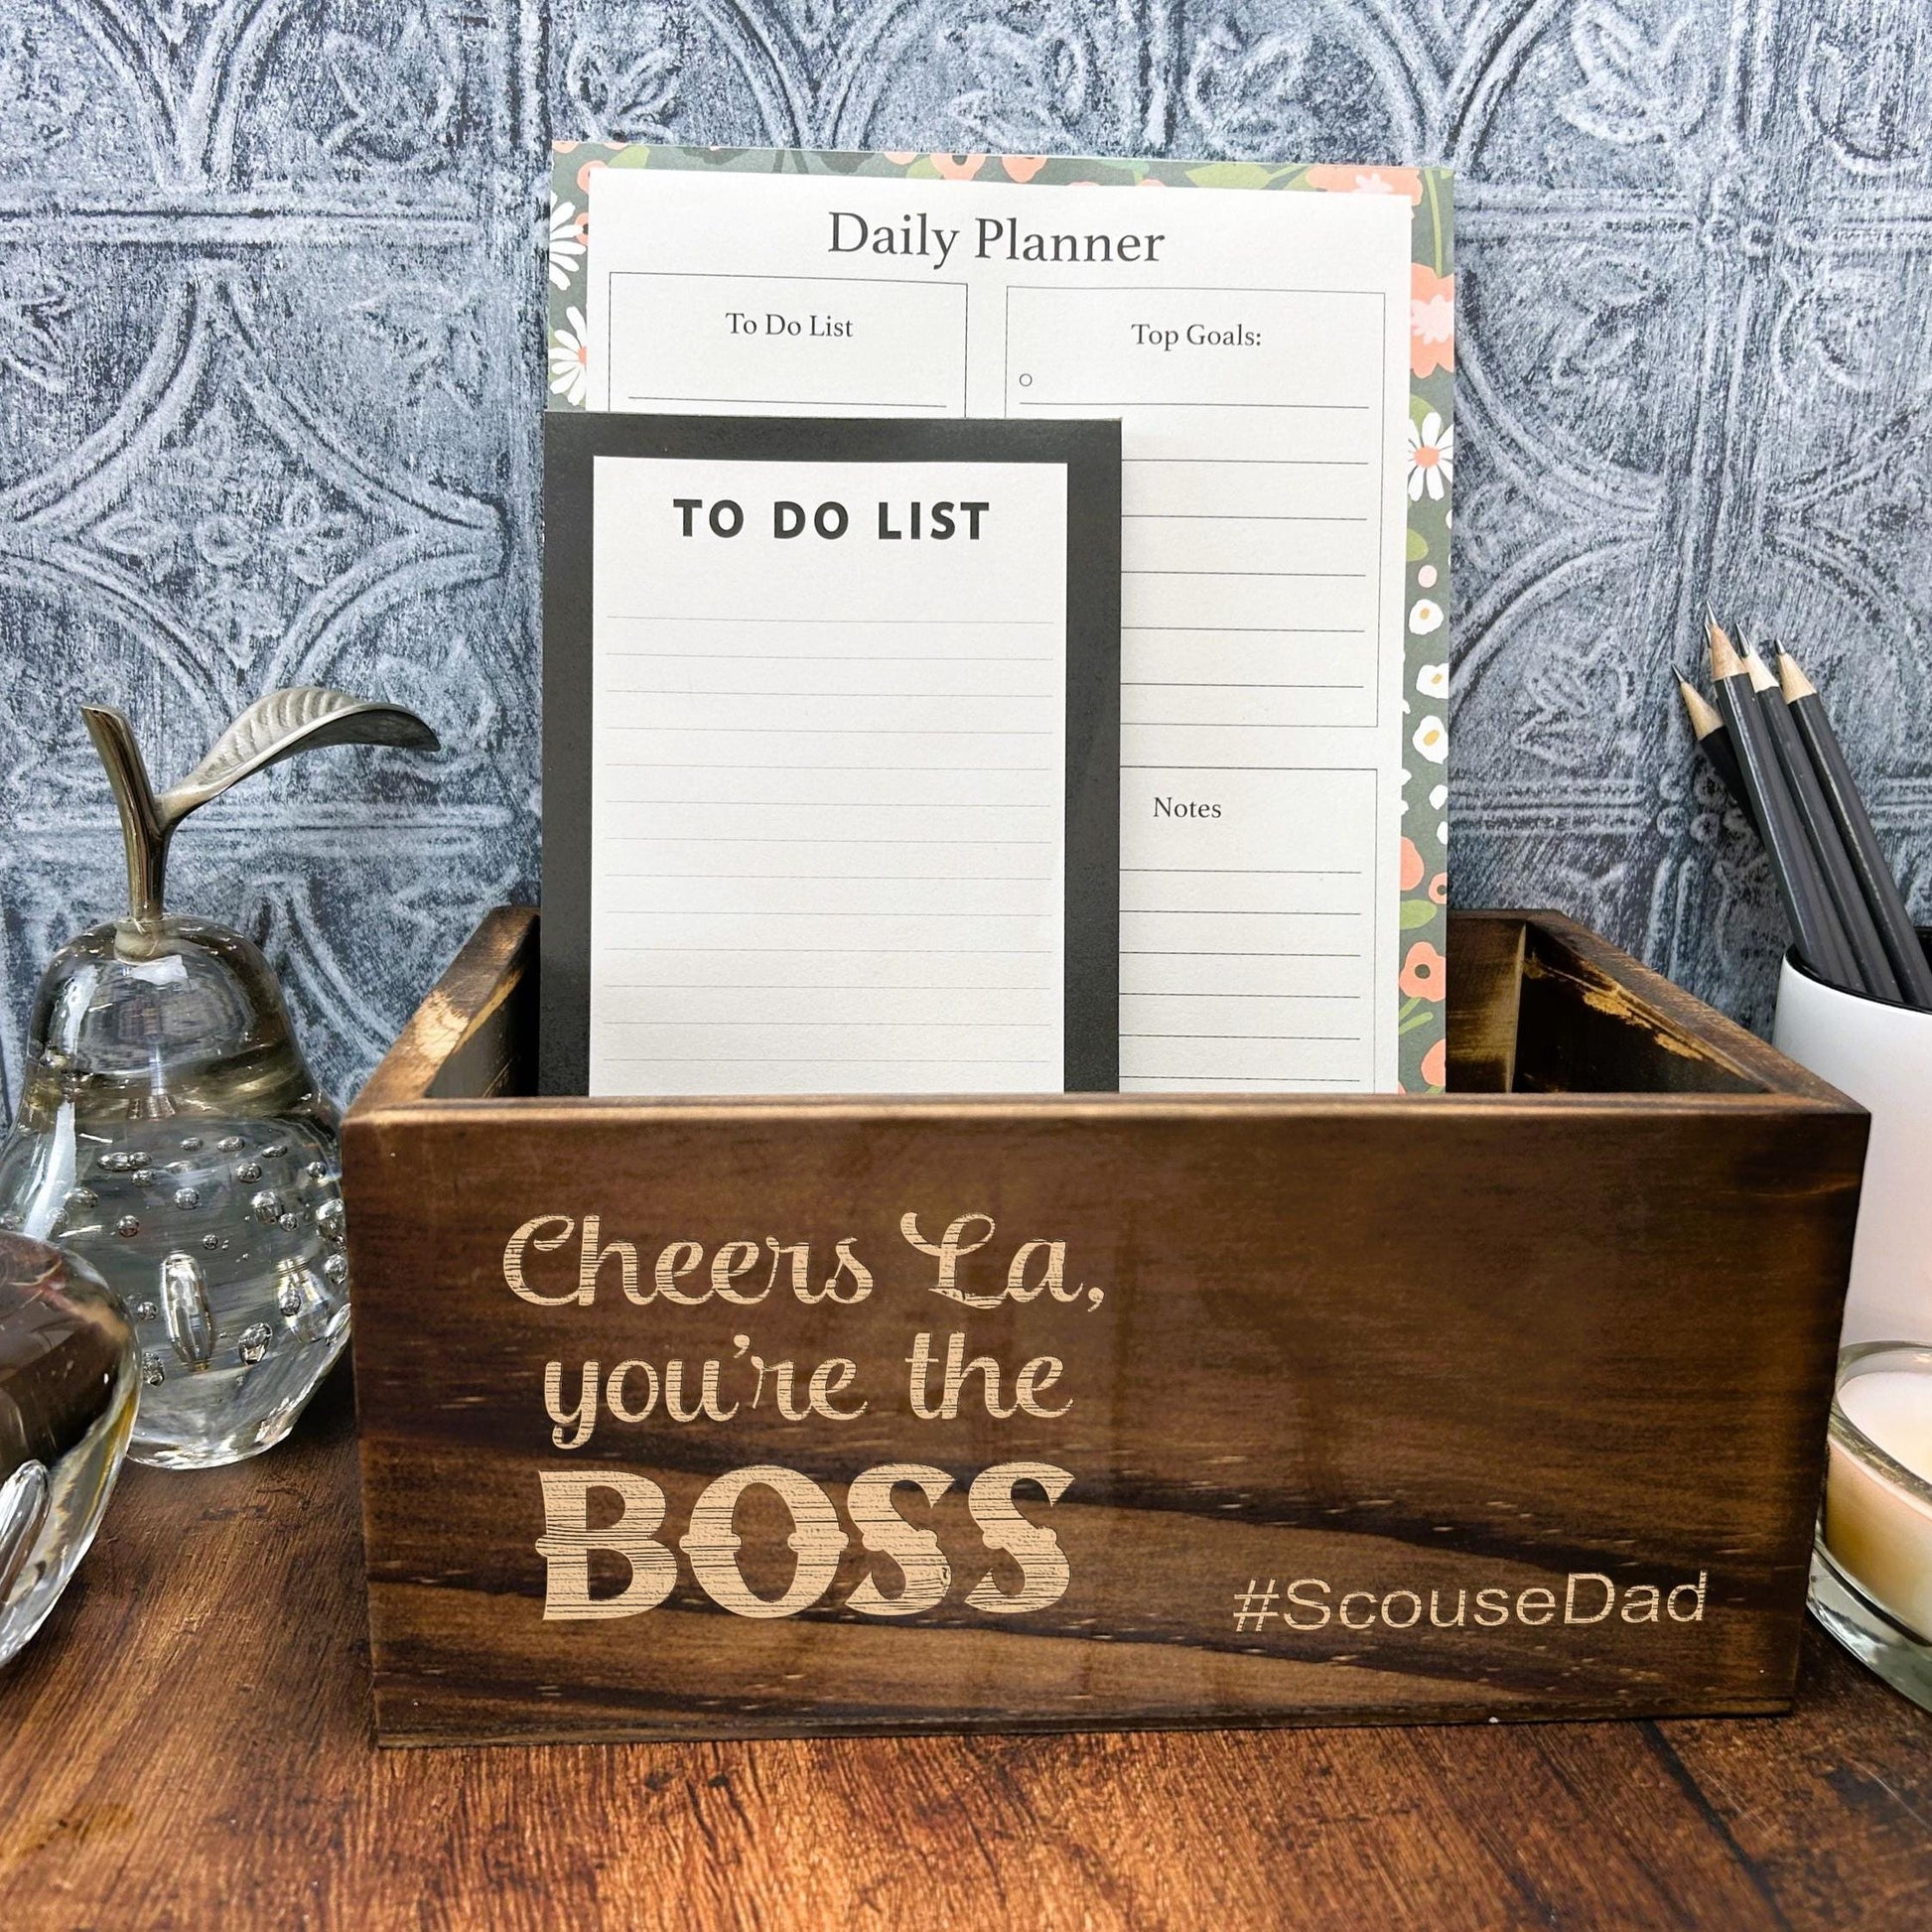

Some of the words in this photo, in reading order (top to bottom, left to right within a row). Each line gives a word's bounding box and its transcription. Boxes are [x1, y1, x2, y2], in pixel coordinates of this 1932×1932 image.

[828, 211, 960, 270] Daily
[975, 217, 1166, 262] Planner
[725, 312, 758, 336] To
[765, 313, 802, 337] Do
[809, 315, 854, 338] List
[1130, 323, 1179, 351] Top
[1185, 323, 1262, 346] Goals:
[672, 498, 745, 539] TO
[773, 500, 849, 540] DO
[878, 500, 991, 540] LIST
[1153, 796, 1222, 819] Notes
[502, 1213, 875, 1307] Cheers
[899, 1211, 1105, 1313] La,
[904, 1330, 1074, 1421] the
[534, 1461, 1076, 1621] BOSS
[1233, 1569, 1709, 1632] #ScouseDad
